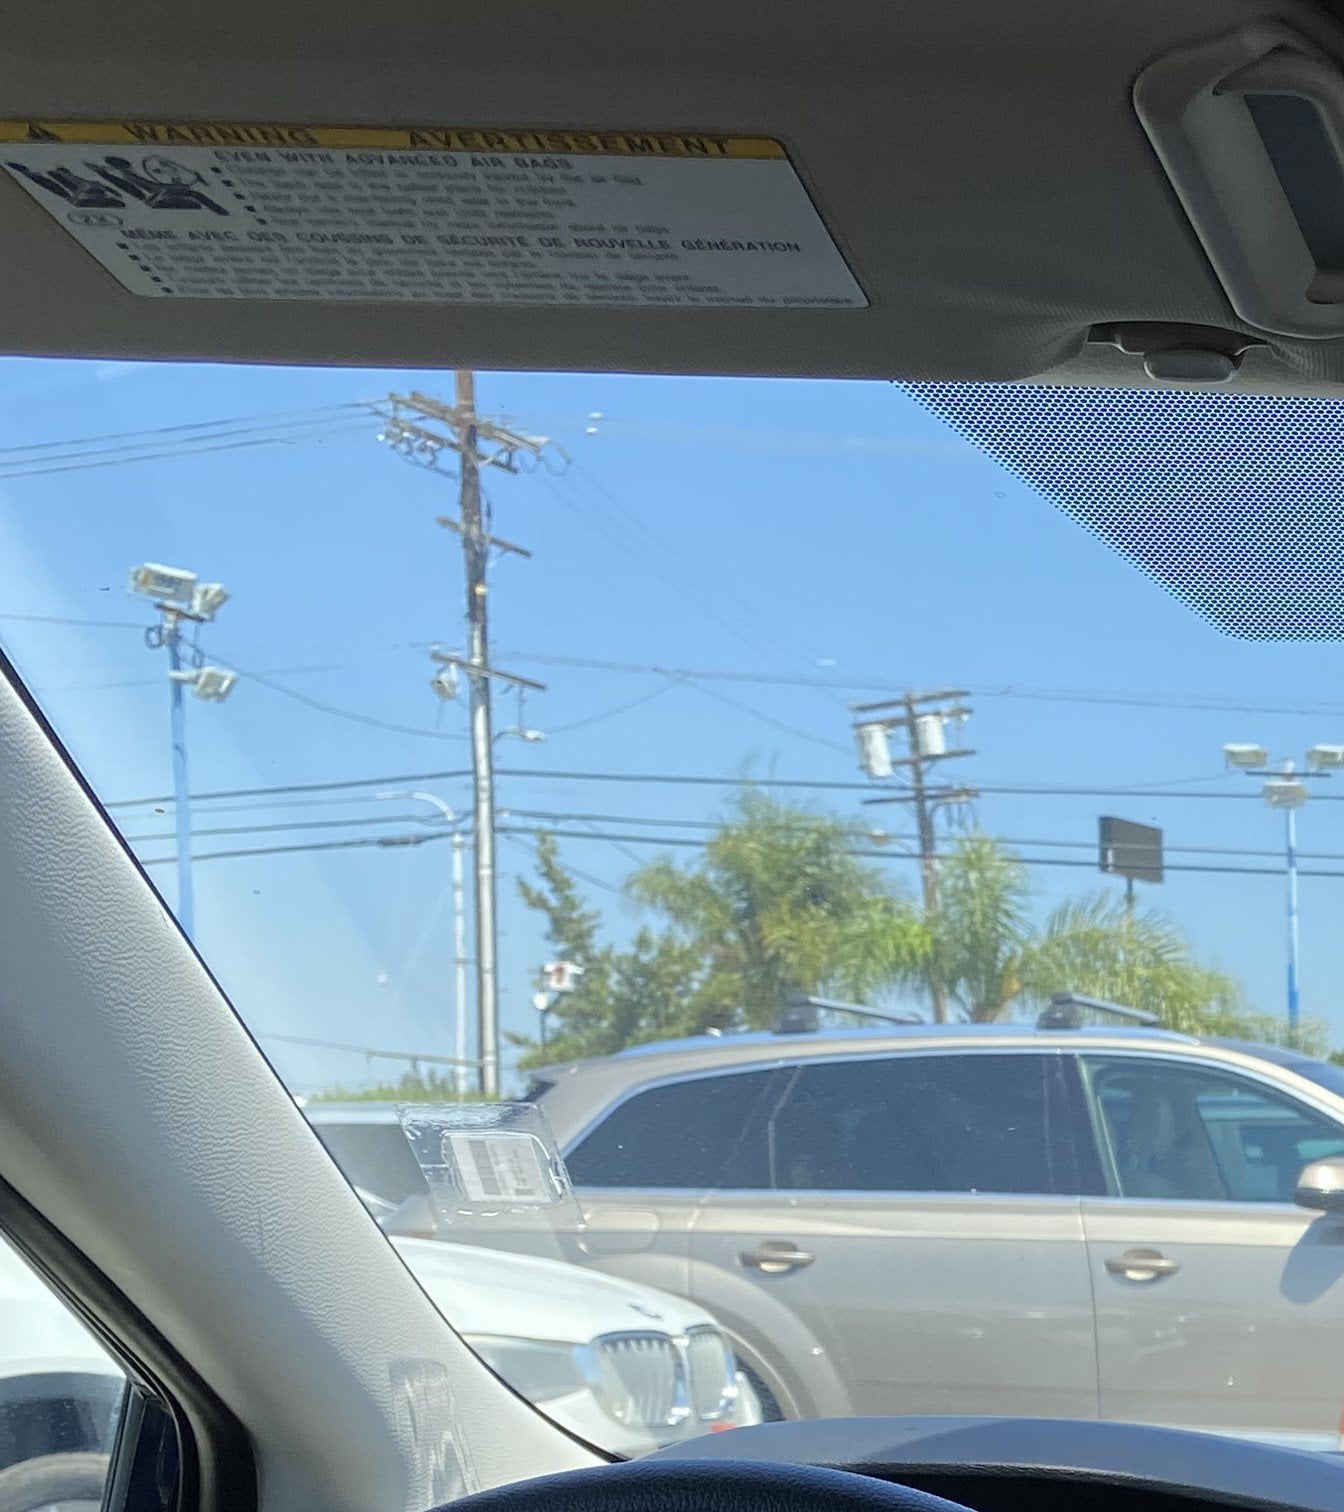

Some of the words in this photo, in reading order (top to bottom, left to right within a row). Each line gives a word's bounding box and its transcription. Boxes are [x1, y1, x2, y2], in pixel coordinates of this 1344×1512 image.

[121, 122, 318, 146] WARNING
[409, 128, 730, 156] AVERTISSEMENT
[471, 156, 504, 169] AIR
[681, 238, 801, 253] GÉNÉRATION
